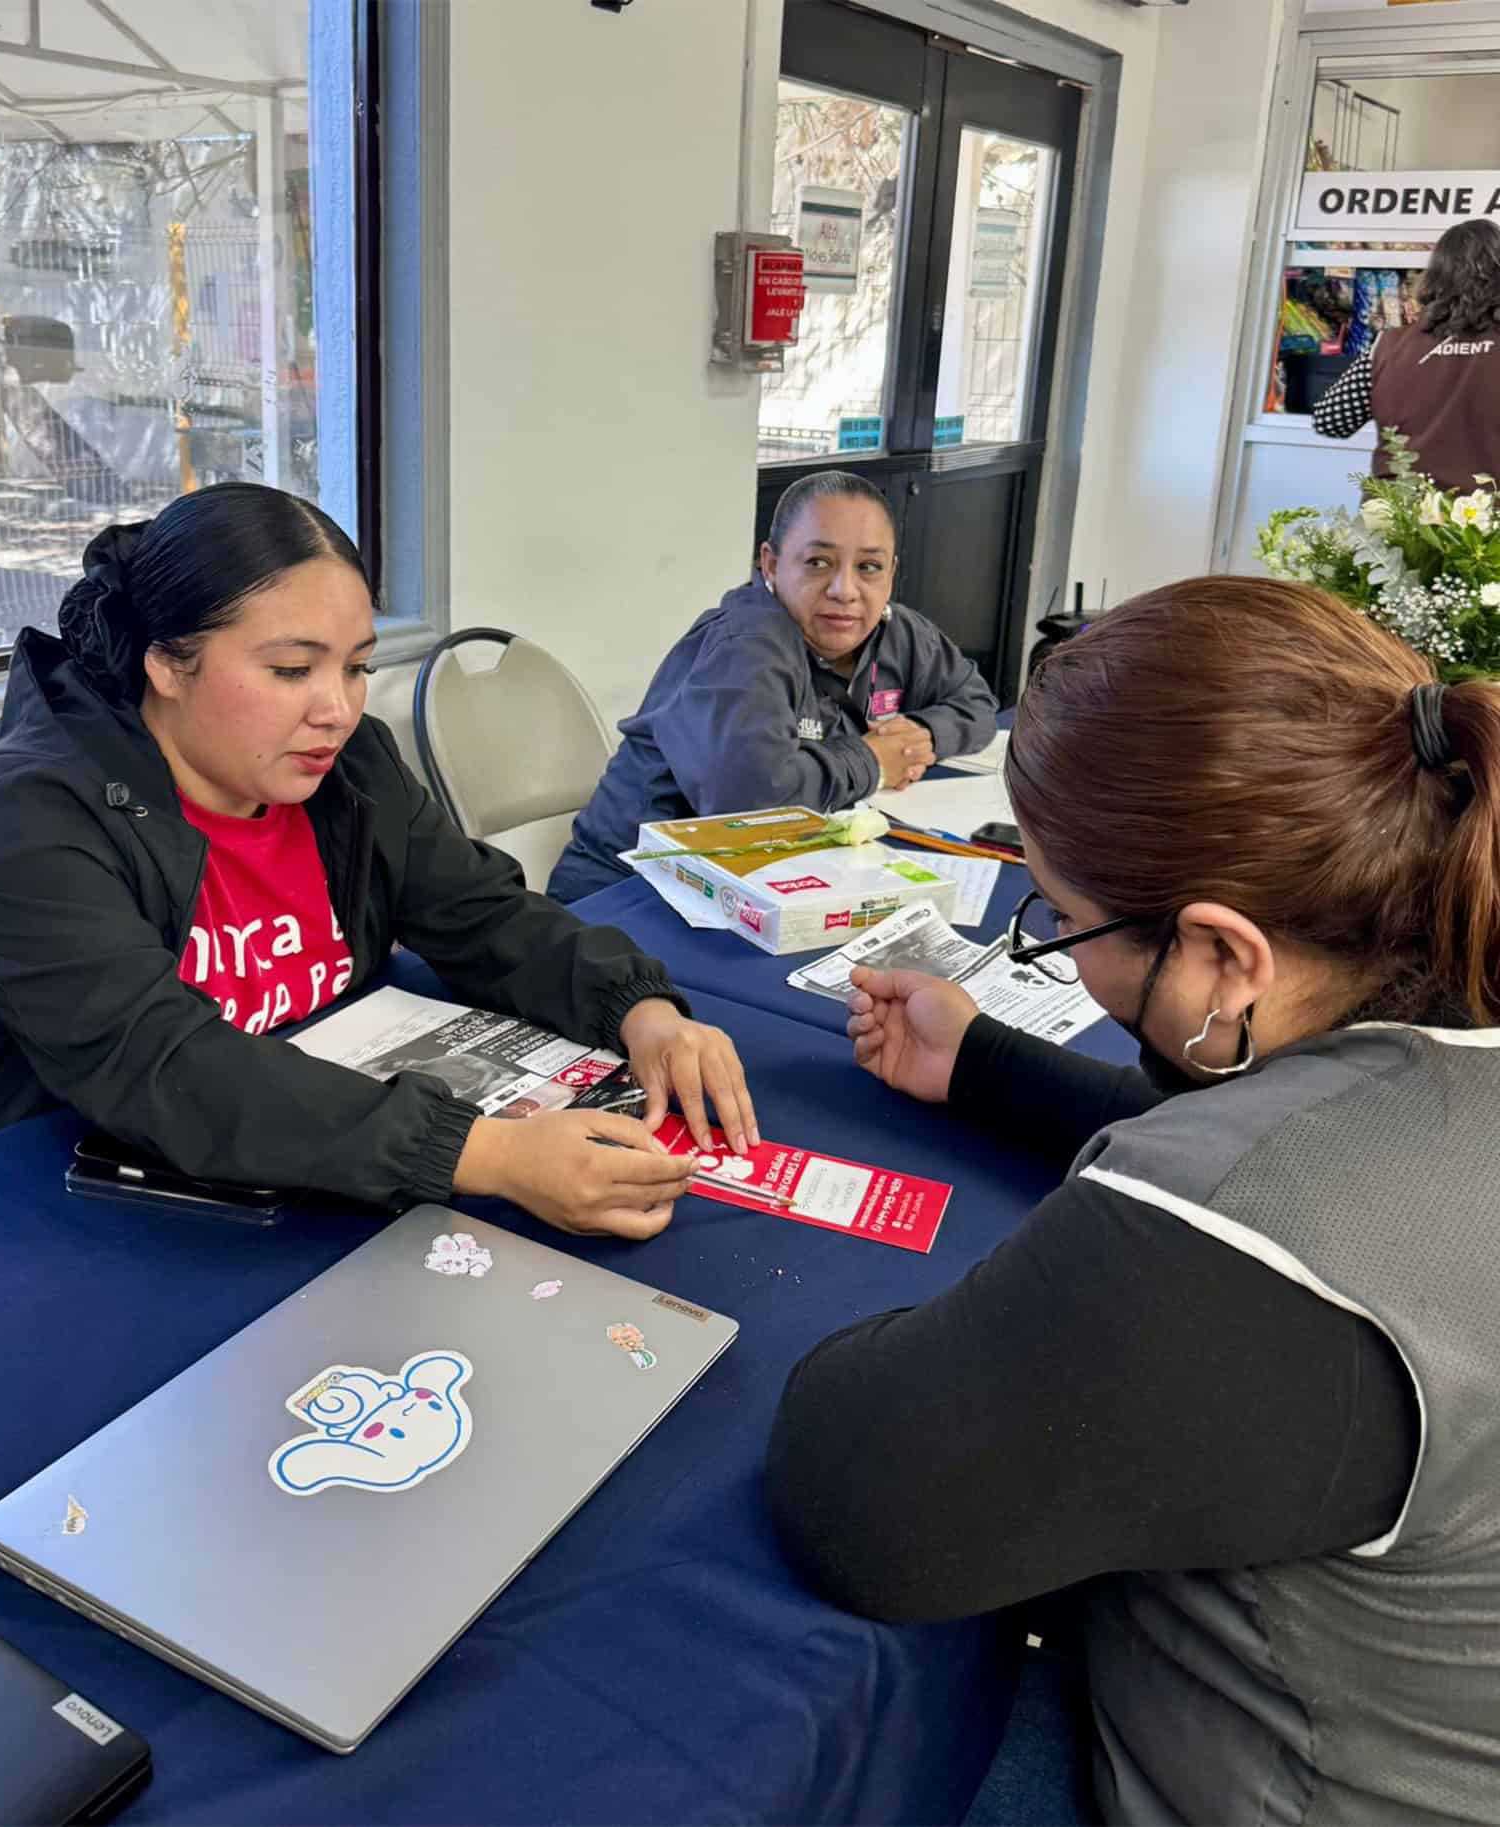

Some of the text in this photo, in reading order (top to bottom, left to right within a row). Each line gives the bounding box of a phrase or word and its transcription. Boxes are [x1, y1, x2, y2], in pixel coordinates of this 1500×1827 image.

[1318, 187, 1473, 215] ORDENE
[1423, 338, 1495, 359] ADIENT
[659, 1295, 704, 1318] Lenovo
[65, 1700, 114, 1738] Lenovo
